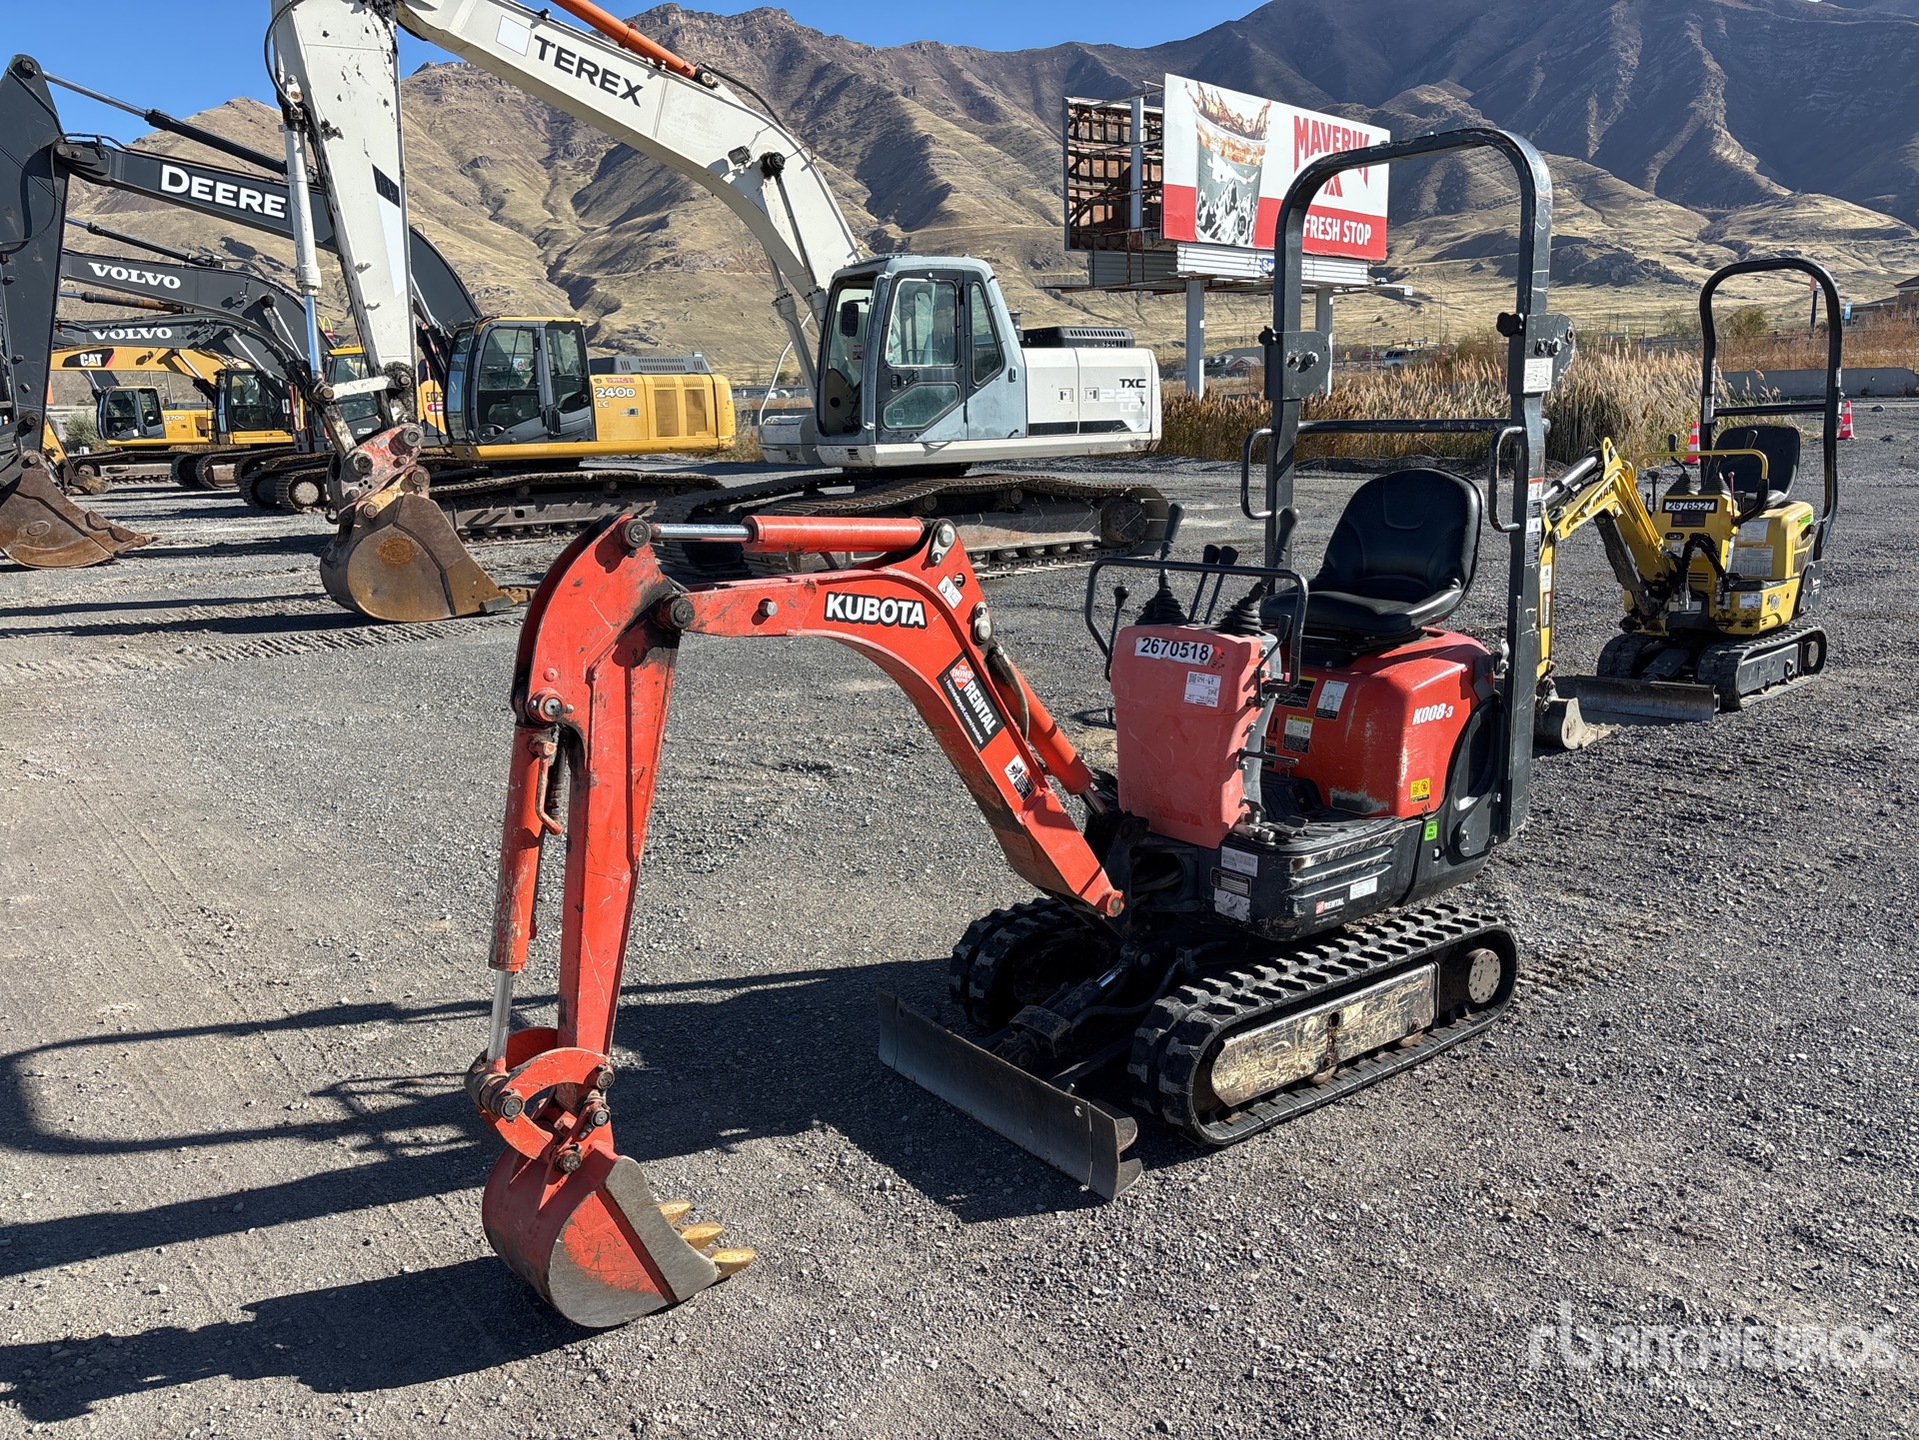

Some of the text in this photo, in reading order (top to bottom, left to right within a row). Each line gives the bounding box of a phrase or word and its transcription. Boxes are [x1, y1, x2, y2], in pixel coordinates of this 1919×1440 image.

[534, 35, 644, 107] TEREX
[161, 164, 286, 218] DEERE
[1303, 214, 1371, 246] FRESH STOP
[88, 262, 181, 289] VOLVO
[91, 327, 172, 340] VOLVO
[80, 354, 102, 366] CAT
[595, 387, 636, 398] 240D
[1119, 379, 1146, 388] TXC
[825, 593, 927, 627] KUBOTA
[1140, 637, 1209, 661] 2670518
[963, 680, 997, 735] RENTAL
[1412, 702, 1454, 725] K008-3
[1324, 897, 1345, 910] RENTAL
